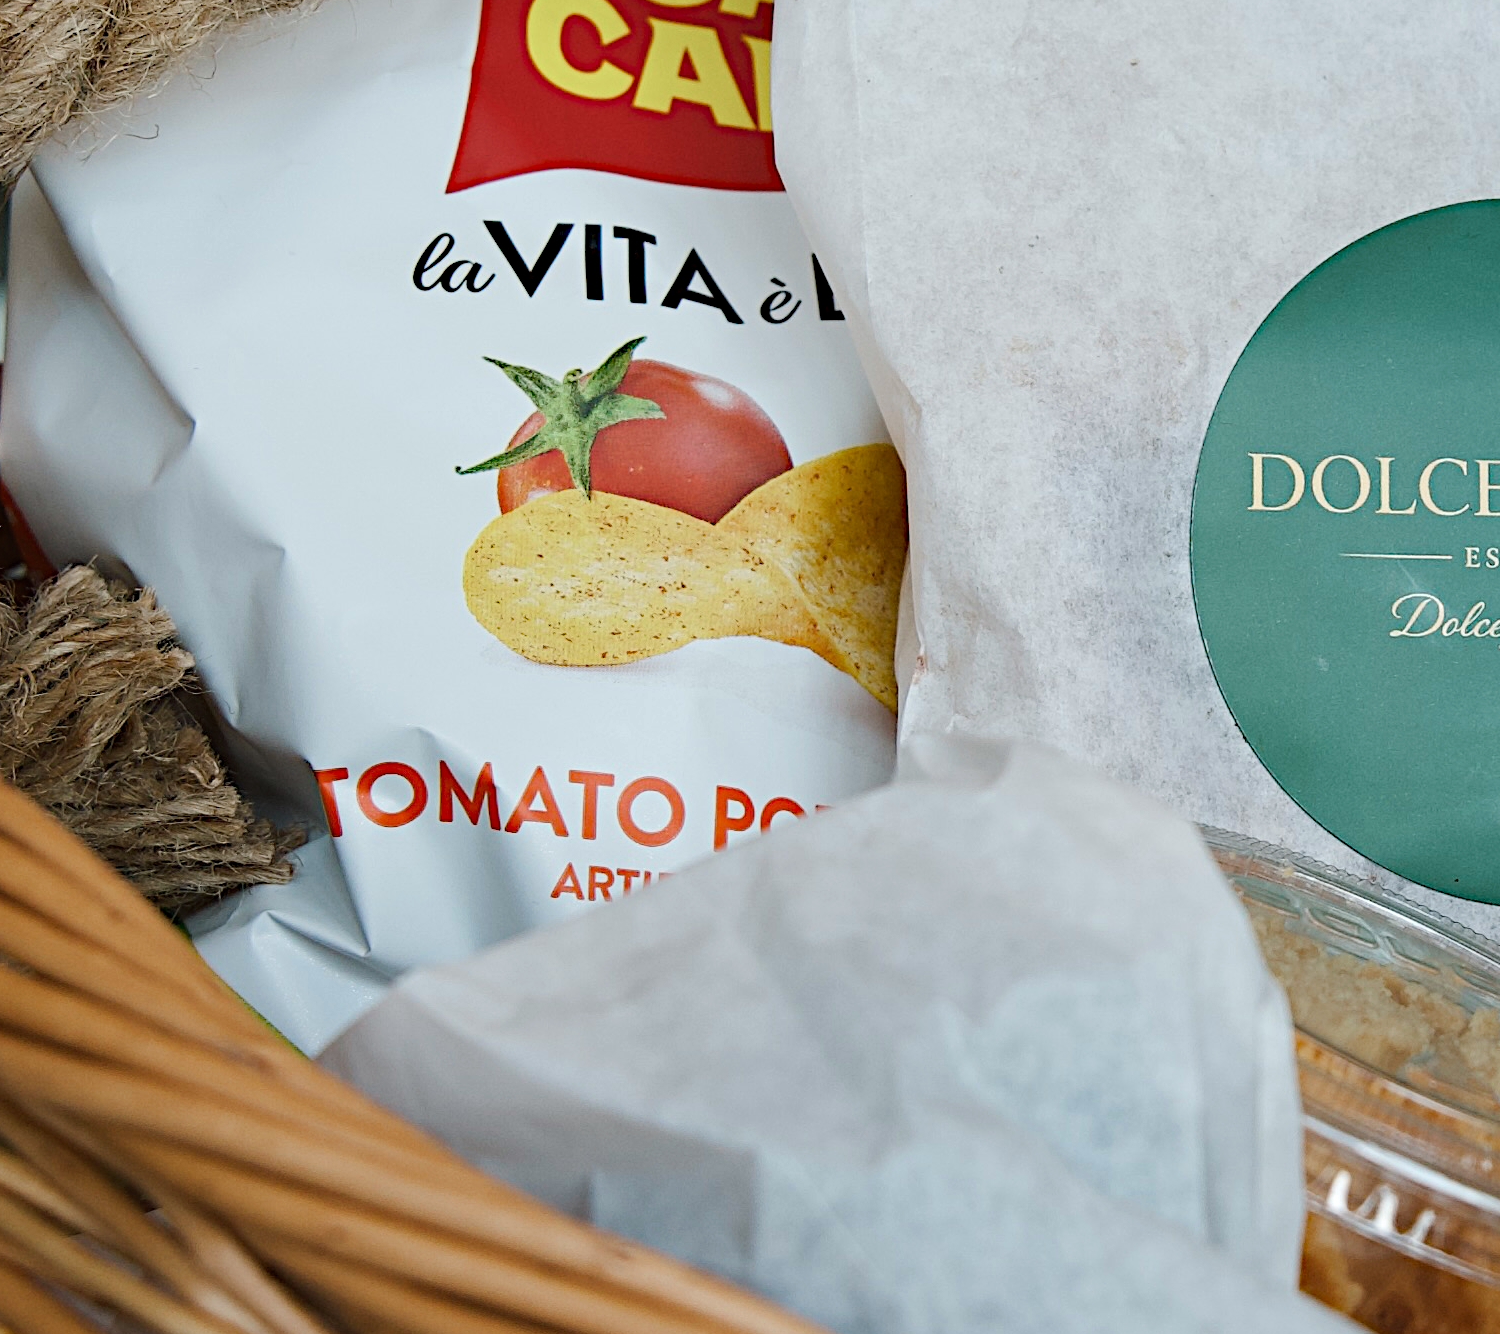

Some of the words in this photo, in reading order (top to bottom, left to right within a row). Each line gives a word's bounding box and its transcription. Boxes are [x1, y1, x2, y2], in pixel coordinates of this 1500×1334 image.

[411, 231, 497, 294] la
[482, 219, 745, 326] VITA
[759, 276, 803, 325] è
[314, 758, 686, 848] TOMATO
